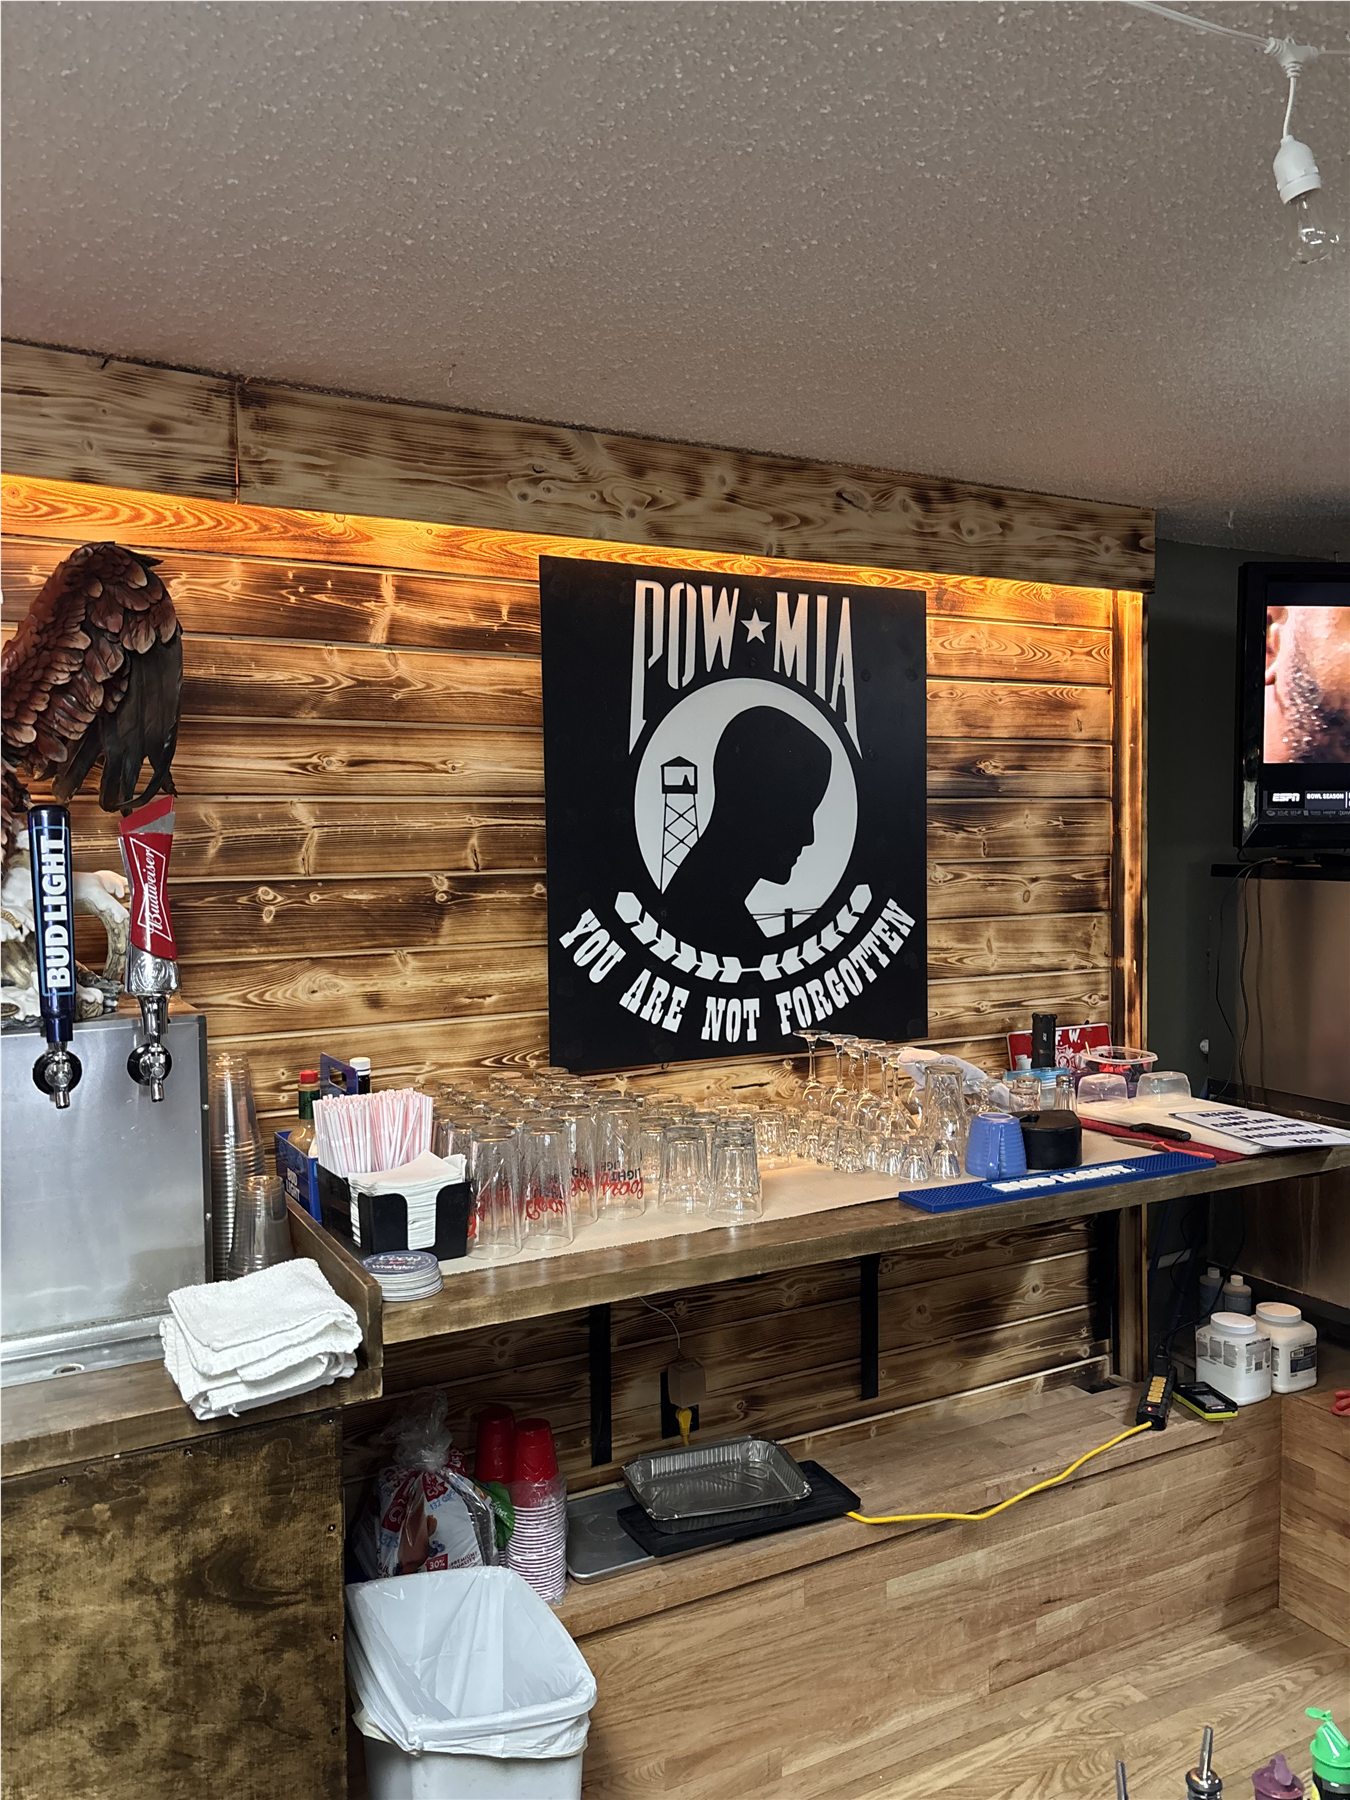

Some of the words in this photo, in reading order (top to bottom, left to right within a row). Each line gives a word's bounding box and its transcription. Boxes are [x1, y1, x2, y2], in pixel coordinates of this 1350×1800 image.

[629, 579, 739, 755] POW
[773, 591, 863, 760] MIA
[1272, 793, 1300, 802] ESPN
[41, 835, 66, 921] LIGHT
[143, 848, 163, 934] Budweiser
[46, 924, 71, 988] BUD
[558, 908, 627, 984] YOU
[618, 968, 690, 1033] ARE
[700, 996, 760, 1043] NOT
[775, 898, 916, 1036] FORGOTTEN
[429, 1559, 446, 1569] 30%
